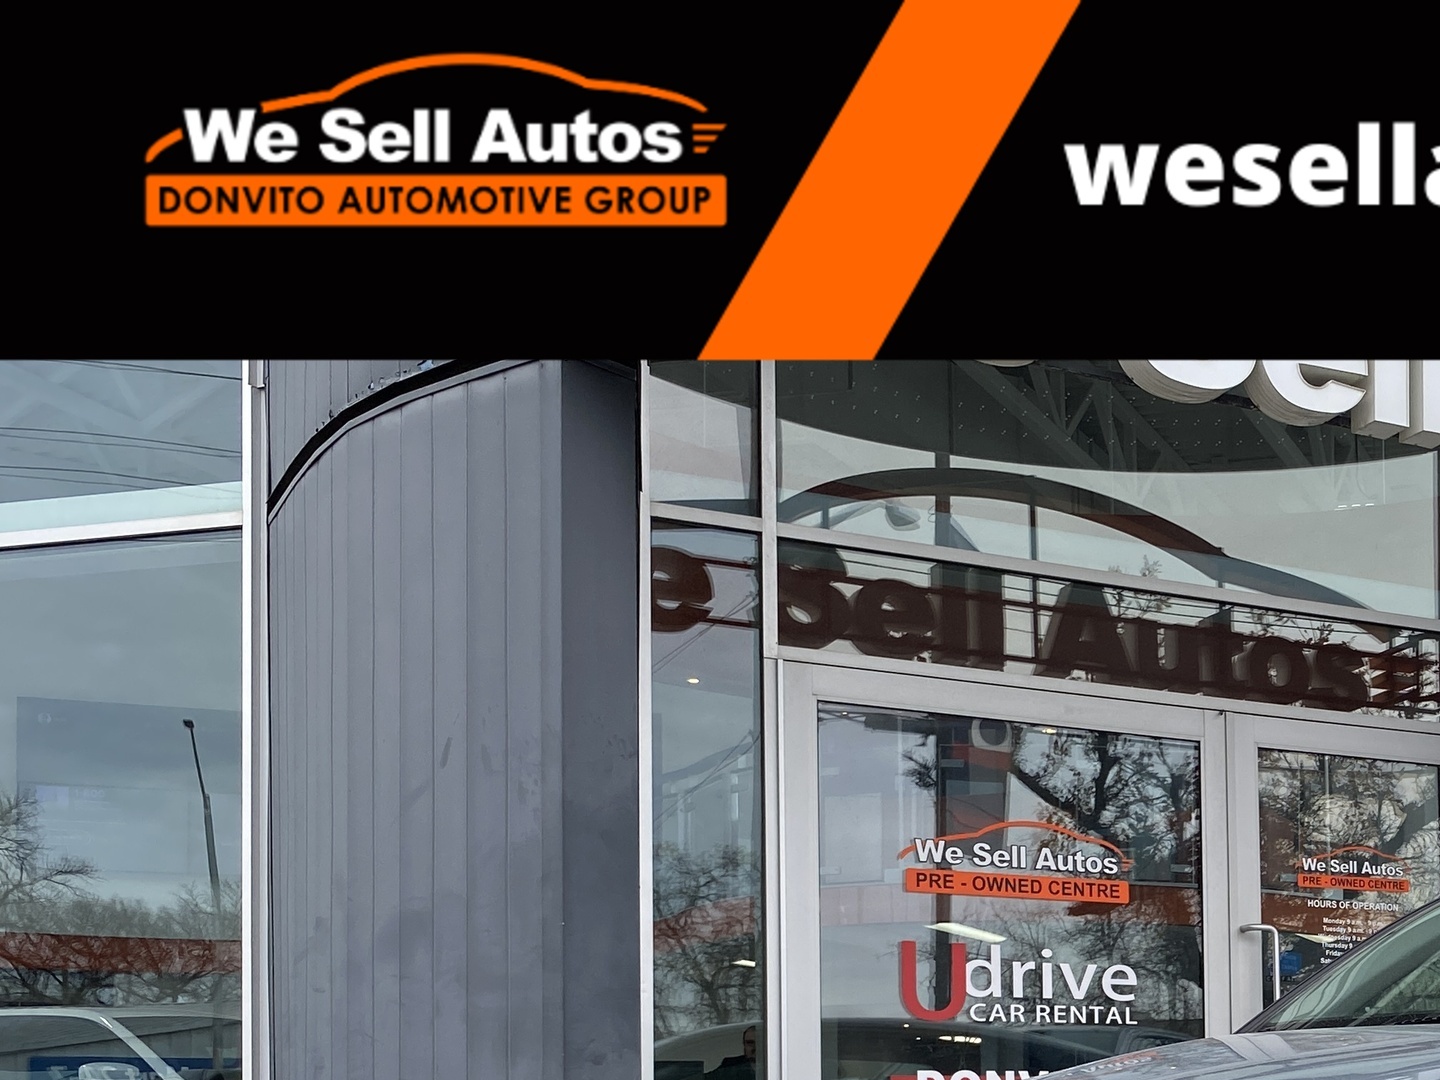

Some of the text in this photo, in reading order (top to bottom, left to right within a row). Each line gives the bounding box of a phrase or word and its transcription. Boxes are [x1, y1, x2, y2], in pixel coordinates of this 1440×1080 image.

[915, 838, 1119, 876] We Sell Autos
[1302, 858, 1404, 876] We Sell Autos
[916, 872, 955, 890] PRE
[972, 876, 1042, 894] OWNED
[1048, 880, 1121, 899] CENTRE
[1302, 877, 1322, 886] PRE
[1330, 878, 1366, 888] OWNED
[1368, 879, 1406, 891] CENTRE
[1307, 899, 1399, 912] HOURS OF OPERATION
[1323, 917, 1346, 925] Monday
[1322, 925, 1346, 934] Tuesday
[1321, 941, 1348, 950] Thursday
[1325, 949, 1344, 957] Frida
[899, 940, 1138, 1022] Udrive
[969, 1003, 1139, 1025] CAR RENTAL
